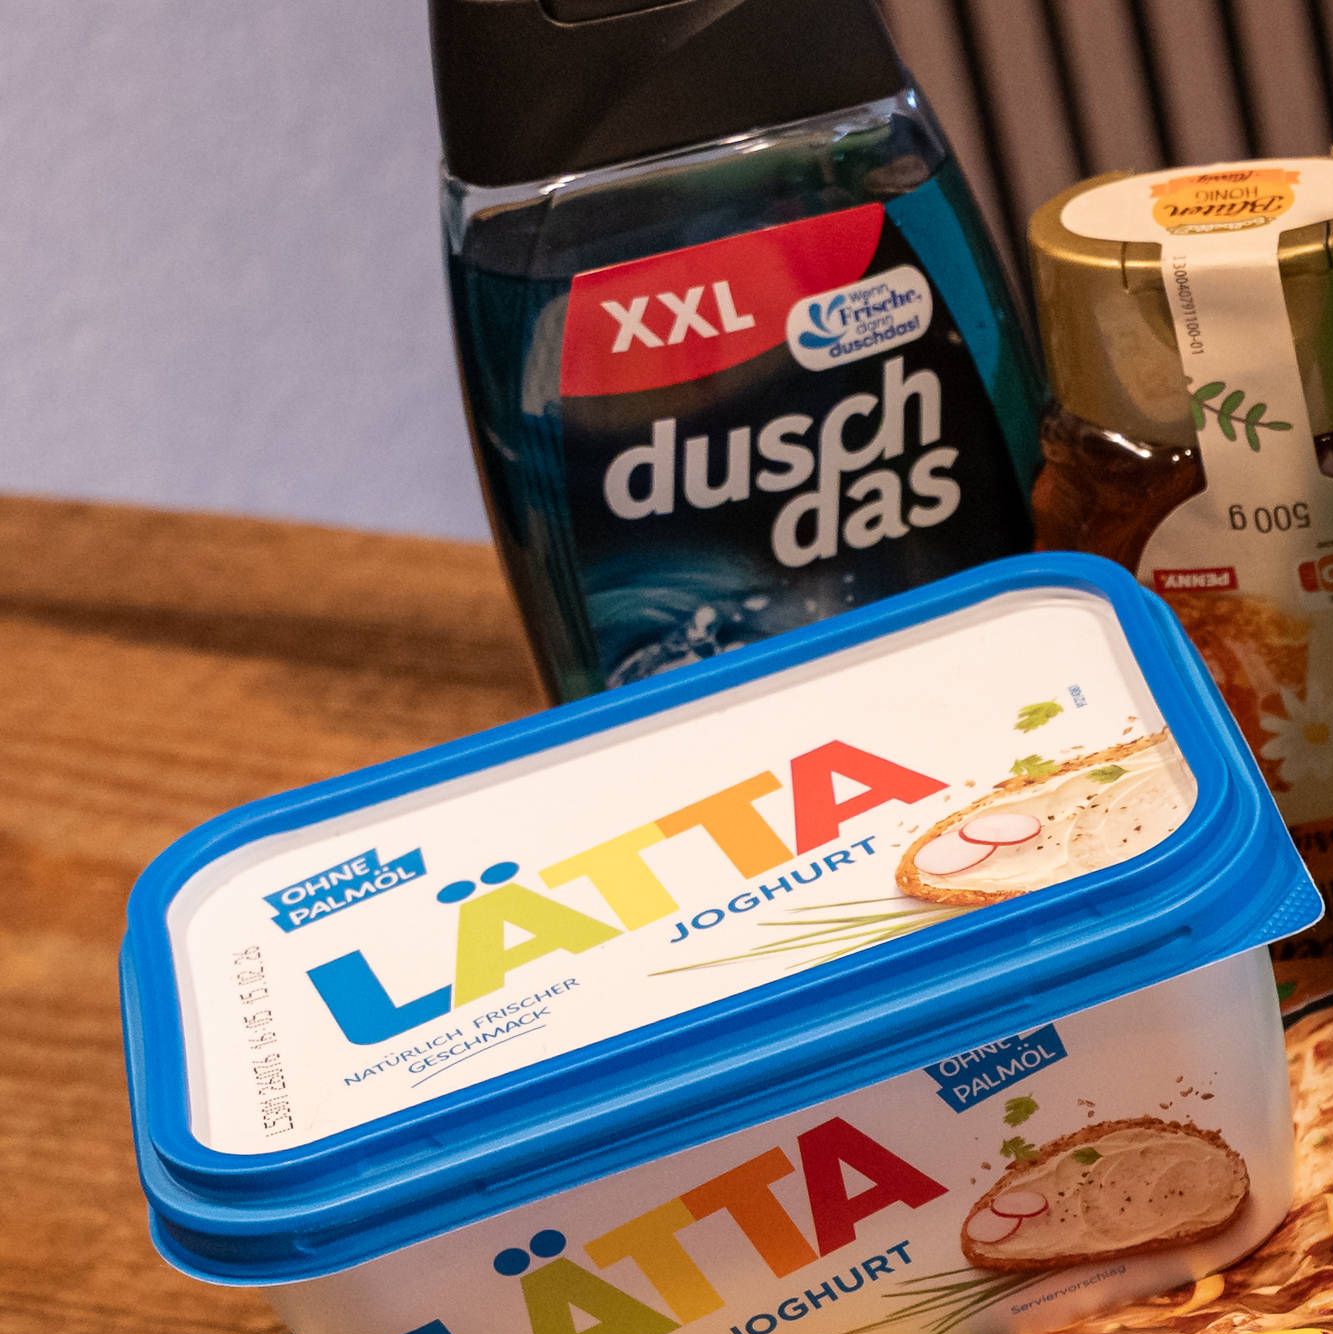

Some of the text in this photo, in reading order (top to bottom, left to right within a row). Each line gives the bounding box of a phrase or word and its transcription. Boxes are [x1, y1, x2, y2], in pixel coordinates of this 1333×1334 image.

[1163, 195, 1287, 217] Blüten
[1196, 185, 1259, 202] HONIG
[601, 280, 756, 354] XXL
[829, 315, 921, 359] duschdas!
[603, 356, 942, 520] dusch
[771, 425, 962, 568] das
[1228, 501, 1311, 534] 500 g
[281, 856, 371, 905] OHNE
[287, 864, 417, 927] PALMÖL
[306, 739, 950, 1045] LÄTTA
[670, 834, 879, 943] JOGHURT
[342, 976, 581, 1088] NATÜRLICH FRISCHER
[407, 1006, 551, 1077] GESCHMACK
[952, 1043, 1057, 1104] PALMÖL
[1009, 1261, 1129, 1318] Serviervorschlag
